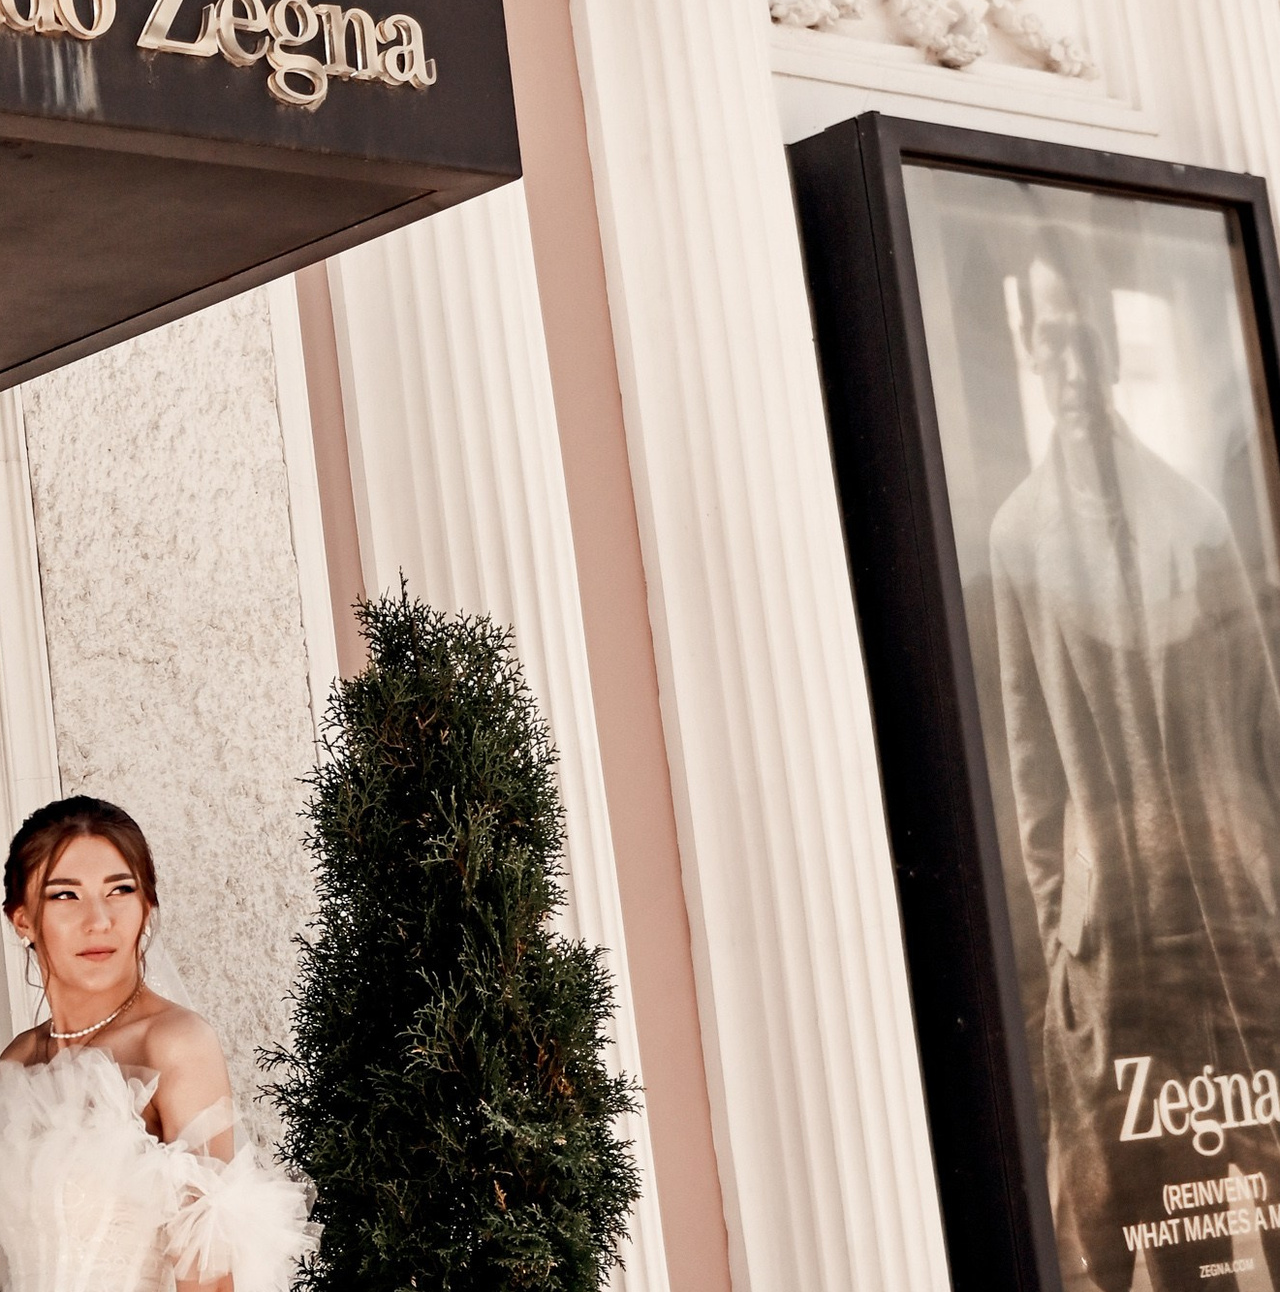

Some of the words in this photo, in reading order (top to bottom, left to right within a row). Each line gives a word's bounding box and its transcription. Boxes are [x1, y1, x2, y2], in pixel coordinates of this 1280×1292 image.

[1114, 1056, 1280, 1156] Zegna
[1162, 1171, 1268, 1215] (REINVENT)
[1122, 1218, 1181, 1252] WHAT
[1184, 1210, 1251, 1243] MAKES
[1255, 1207, 1268, 1231] A
[1199, 1258, 1255, 1279] ZEGNA.COM
